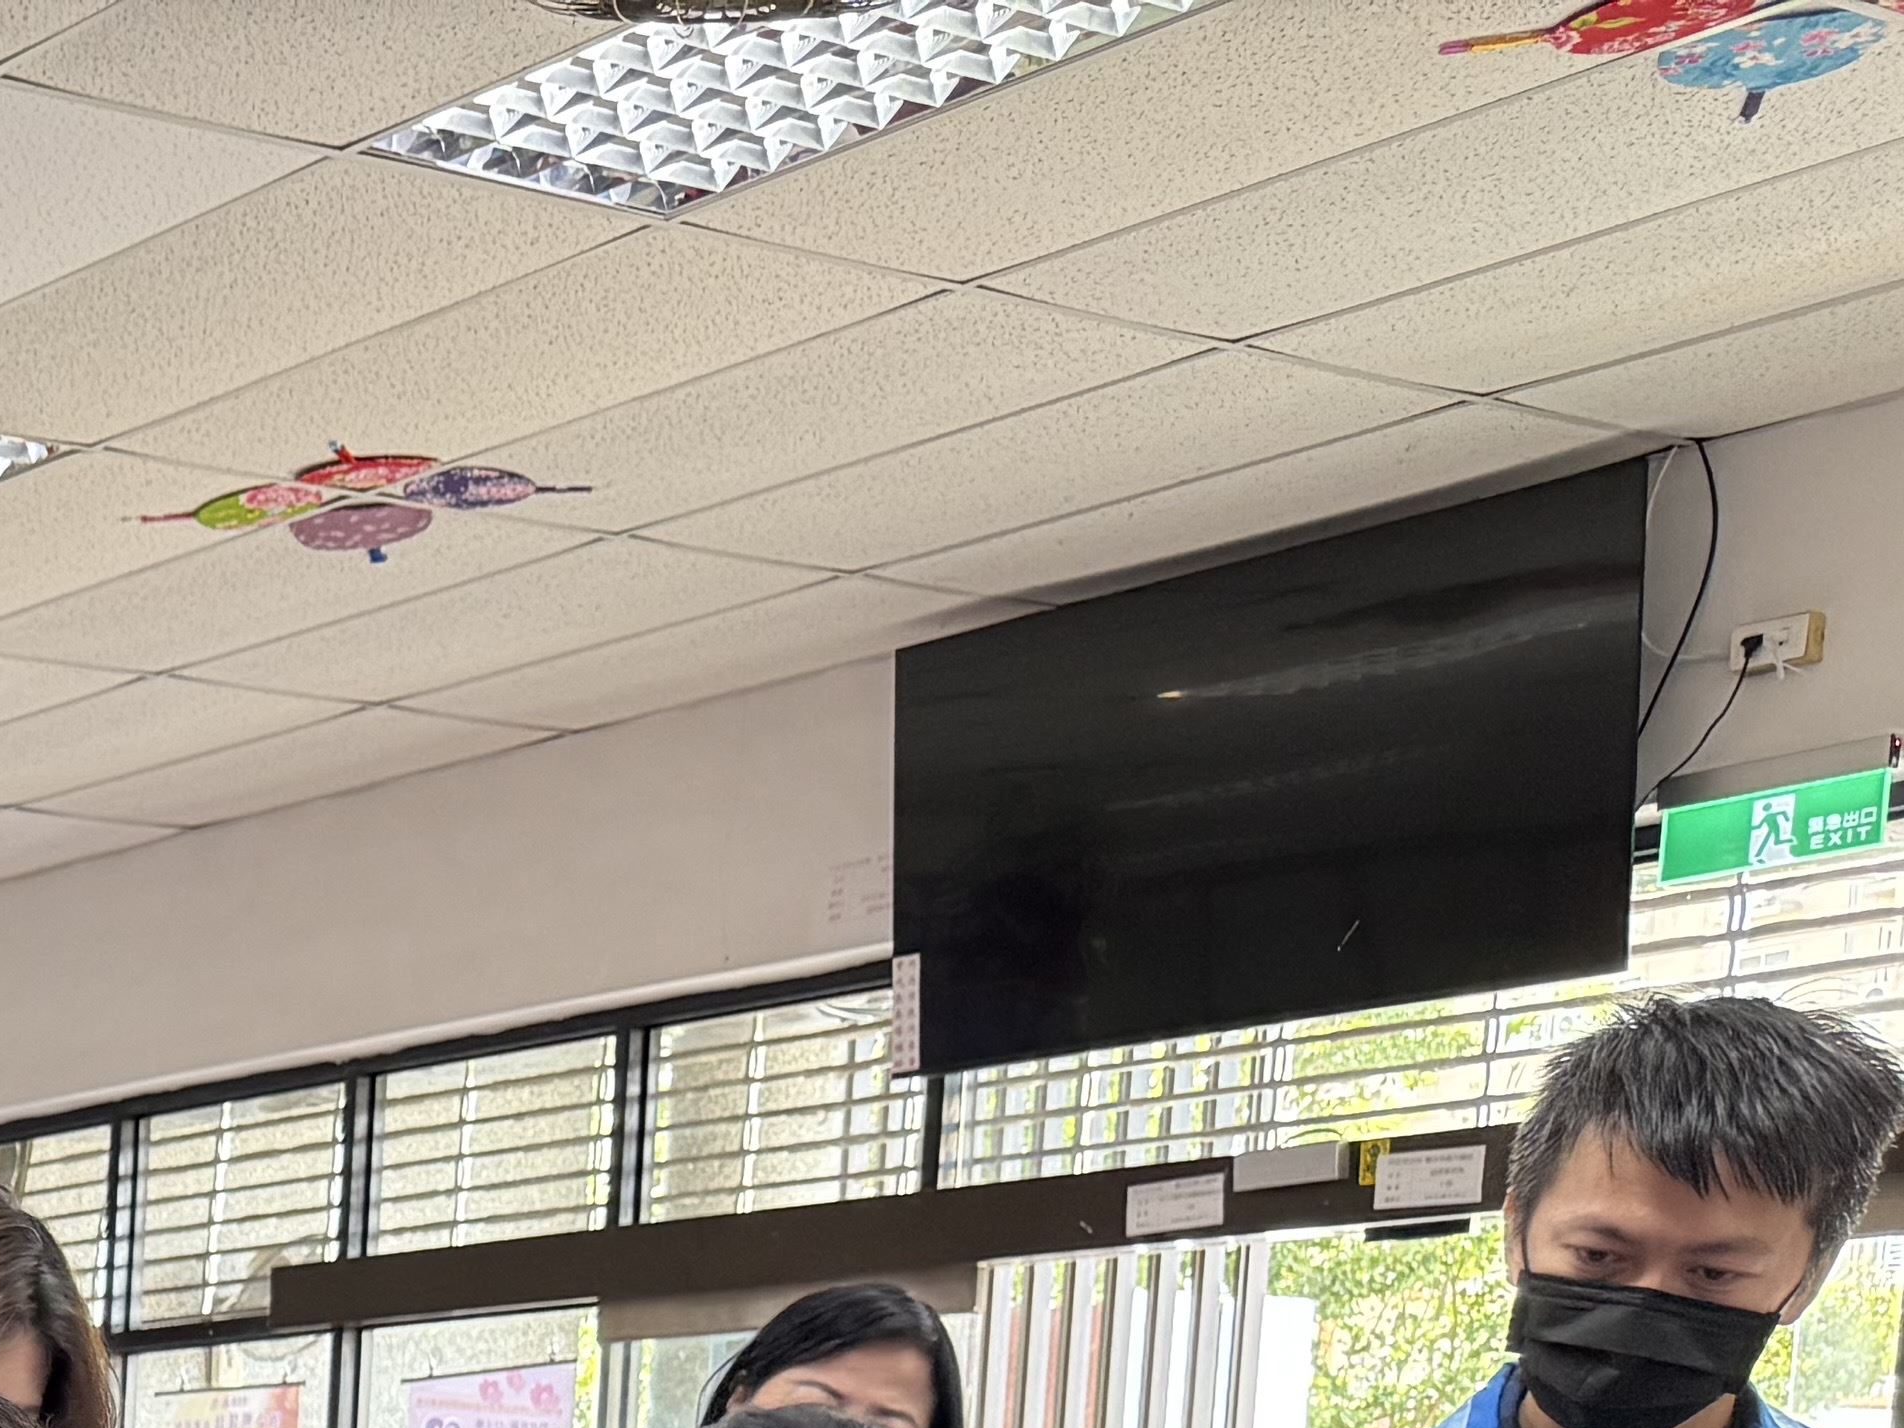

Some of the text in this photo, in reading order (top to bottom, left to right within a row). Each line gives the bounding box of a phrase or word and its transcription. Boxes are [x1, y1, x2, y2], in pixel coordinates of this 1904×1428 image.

[1808, 806, 1877, 834] 緊急出口
[1810, 825, 1872, 850] EXIT
